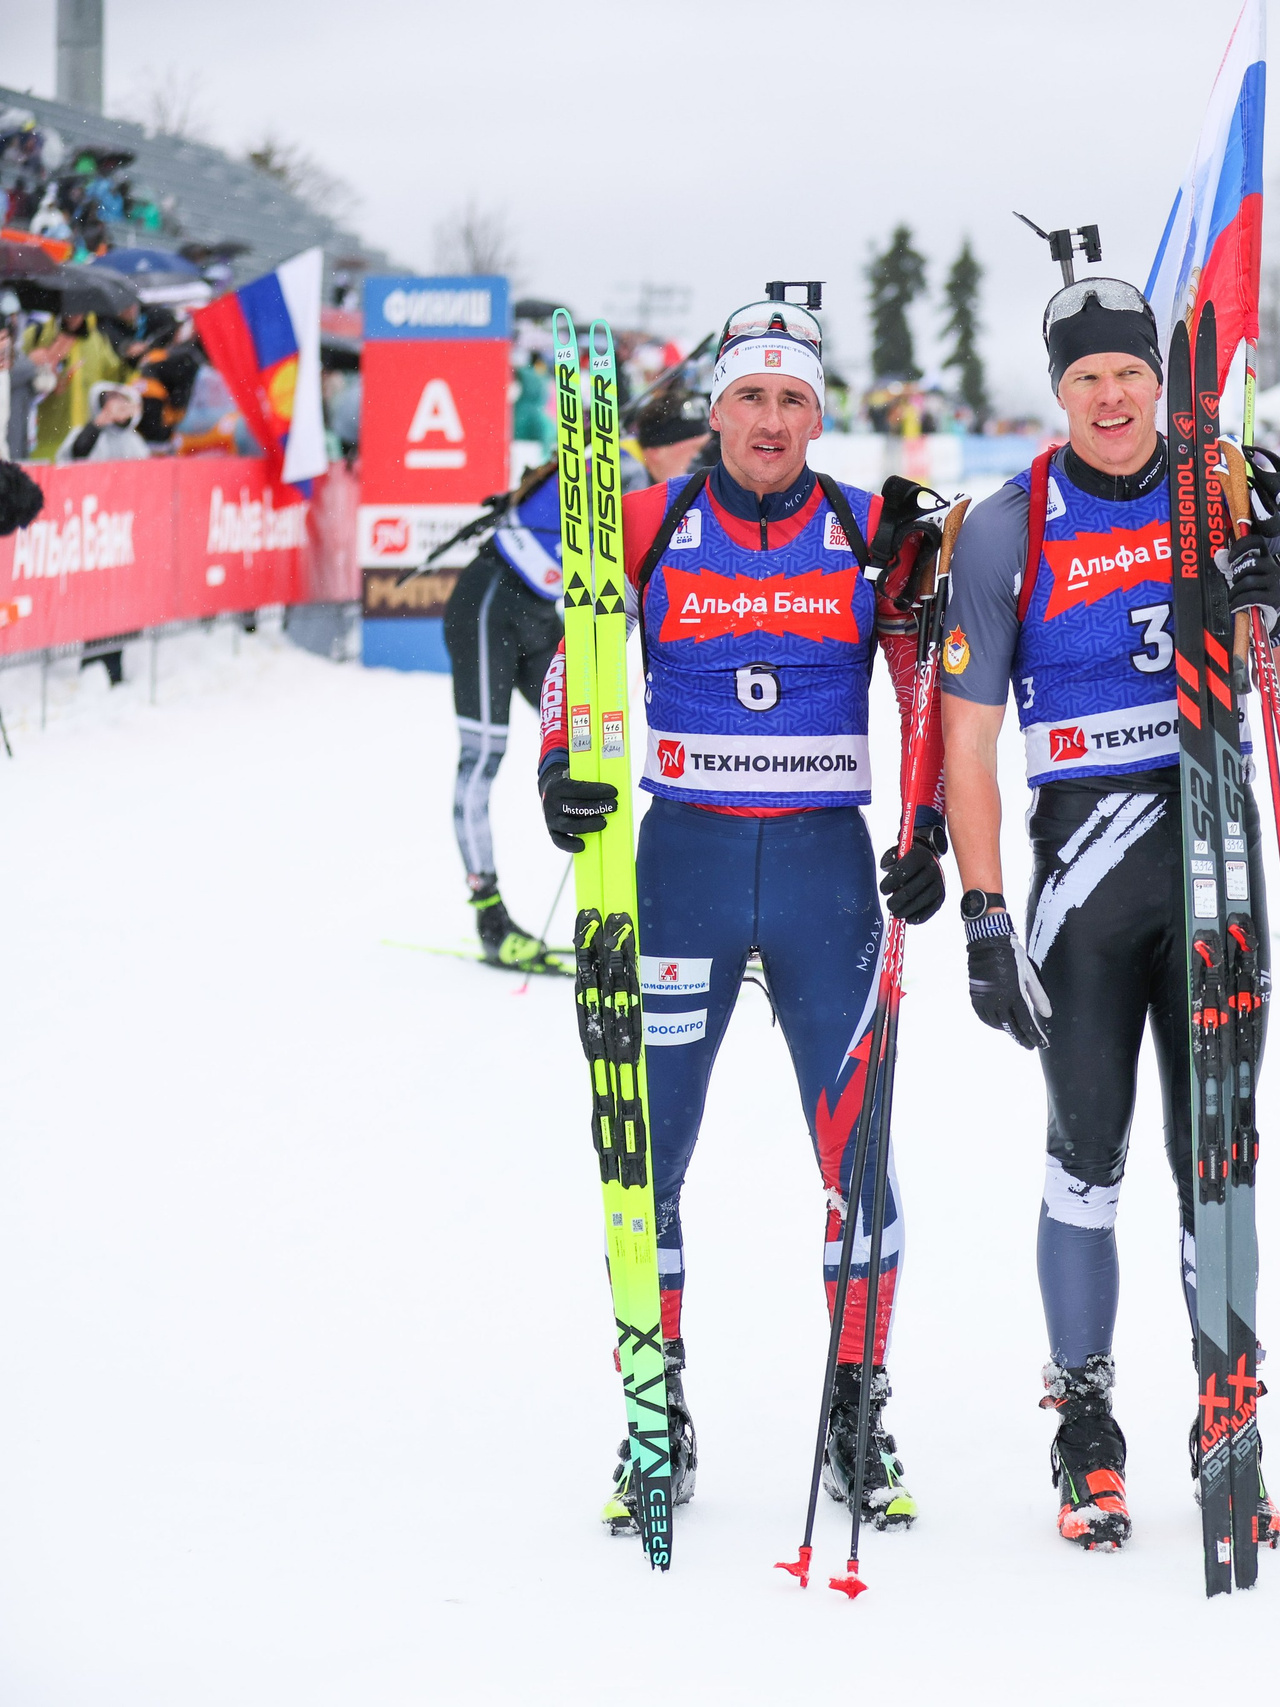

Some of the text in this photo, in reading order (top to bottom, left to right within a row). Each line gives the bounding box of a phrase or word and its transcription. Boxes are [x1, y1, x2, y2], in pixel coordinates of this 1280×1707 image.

[383, 288, 491, 327] ФИНИШ
[559, 363, 583, 556] FISCHER
[594, 374, 618, 564] FISCHER
[1178, 458, 1198, 579] ROSSIGNOL
[1068, 546, 1150, 582] Альфа
[680, 592, 841, 617] Альфа Банк
[1128, 602, 1175, 675] 3
[736, 661, 782, 712] 6
[1021, 677, 1034, 710] 3
[690, 753, 857, 773] ТЕХНОНИКОЛЬ
[562, 804, 613, 816] Unstoppable
[856, 917, 882, 971] MOAX
[641, 982, 707, 991] РОМФИНСТРОЙ
[648, 1020, 704, 1035] ФОСАГРО
[630, 1322, 671, 1477] MAX
[650, 1488, 669, 1565] SPEED
